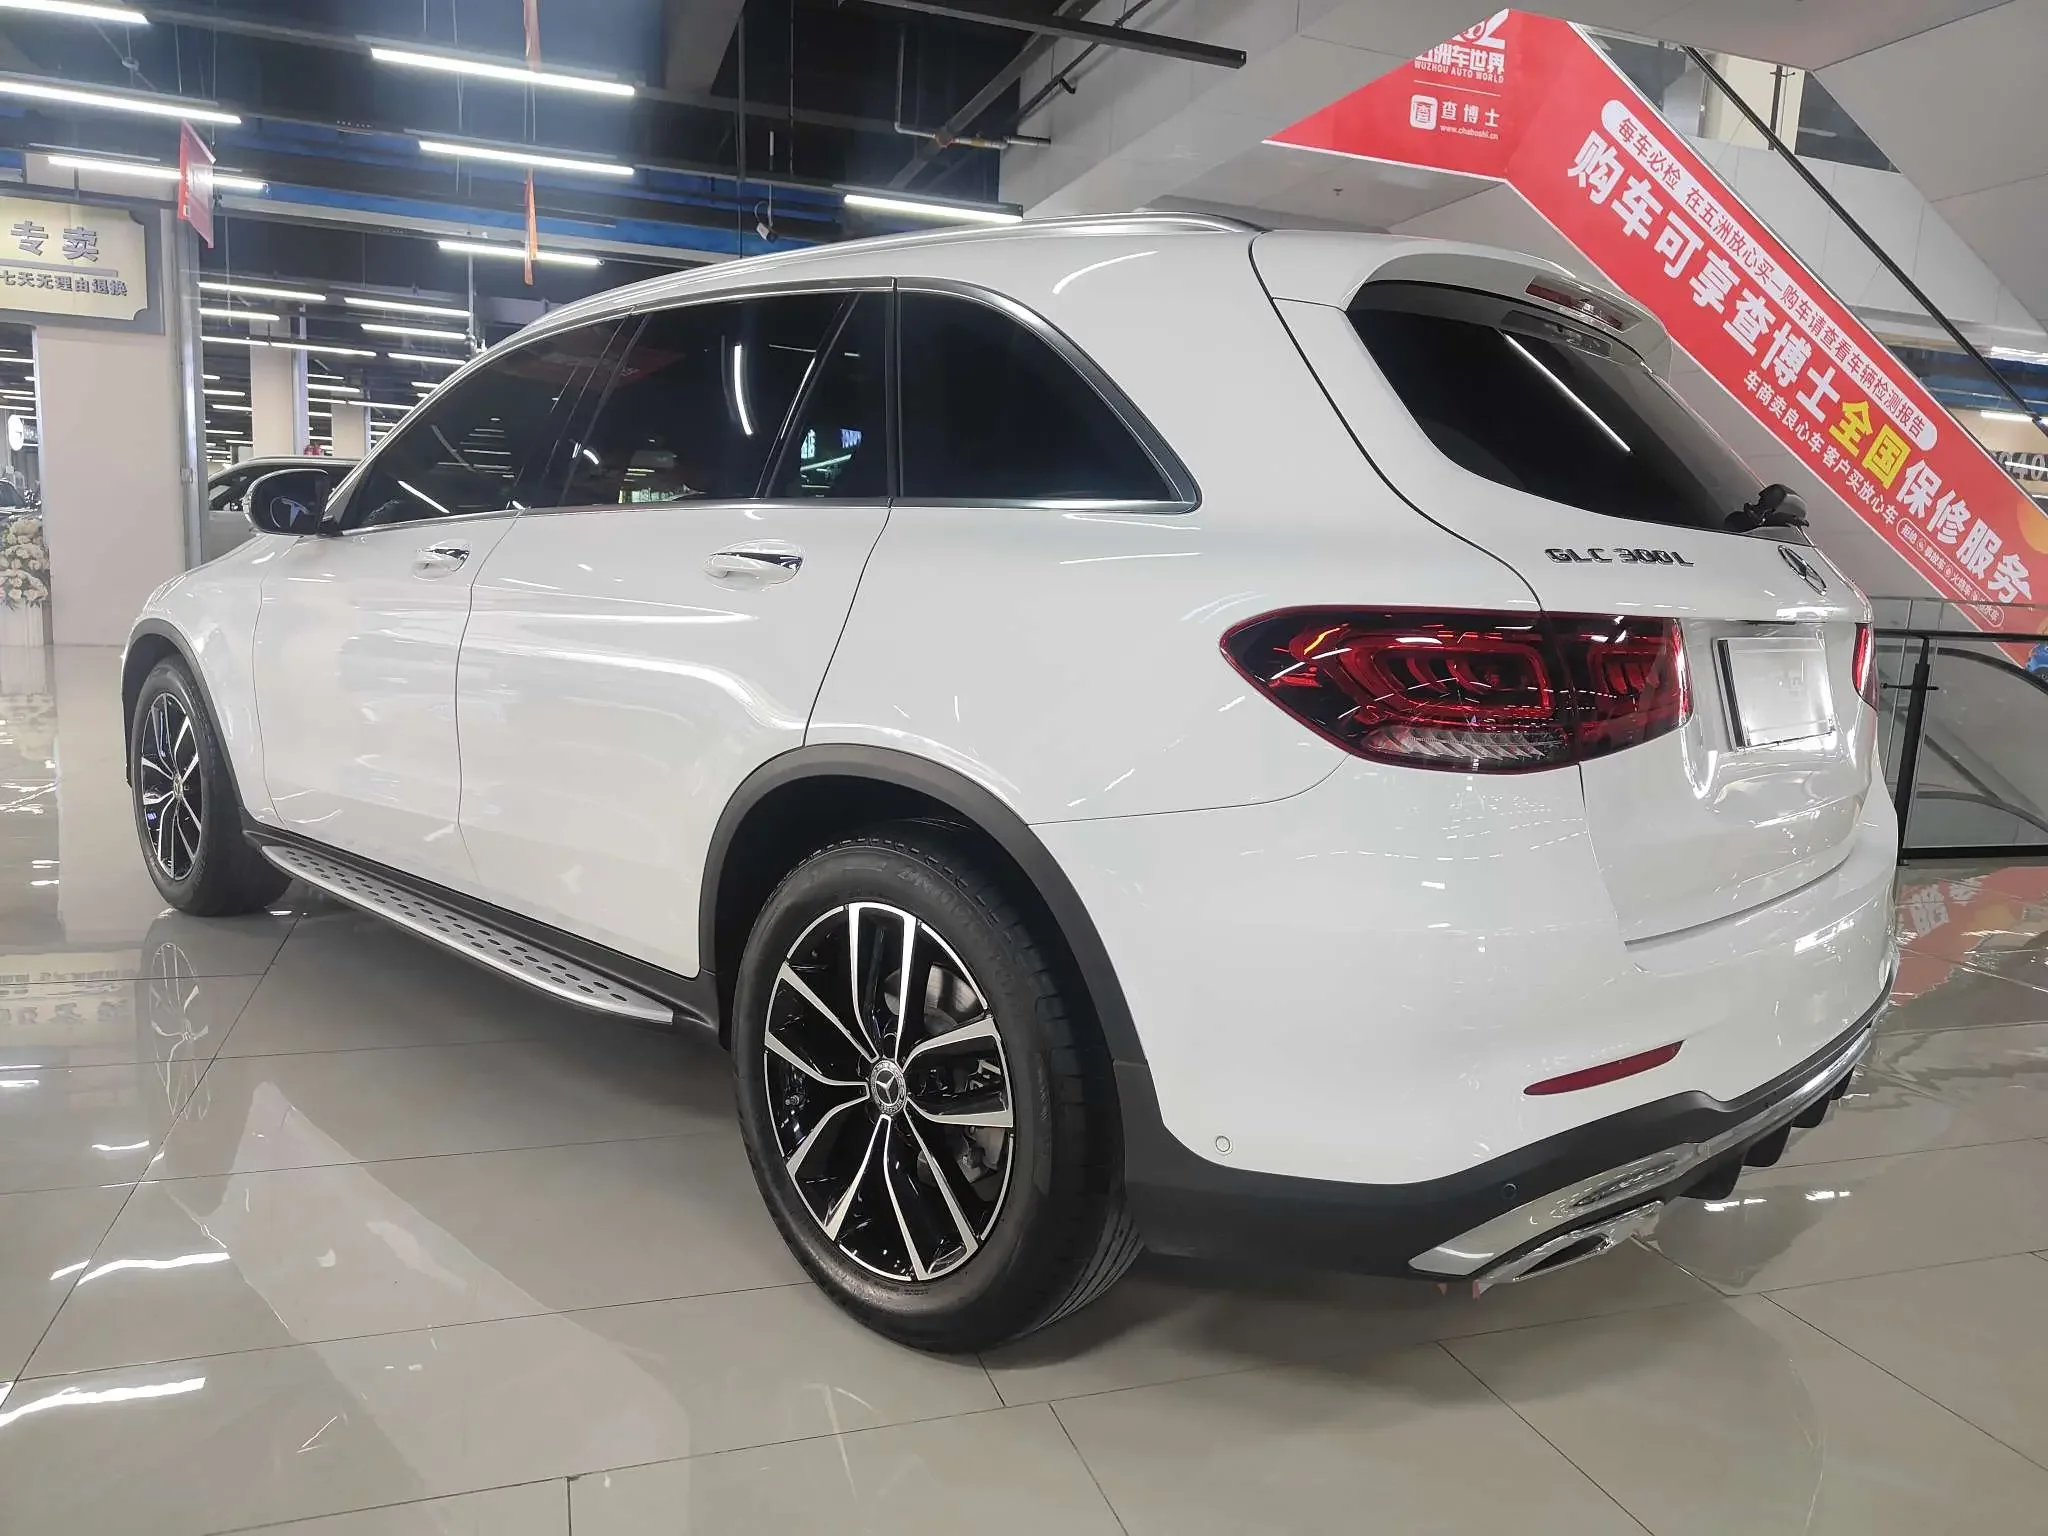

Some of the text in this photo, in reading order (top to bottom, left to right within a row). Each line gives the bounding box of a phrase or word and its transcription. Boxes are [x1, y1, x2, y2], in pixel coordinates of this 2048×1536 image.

[1414, 60, 1505, 84] WUZHOU AUTO WORLD
[1441, 100, 1500, 128] 查博士
[1618, 118, 1682, 191] 每车必检
[11, 220, 98, 262] 专卖
[0, 270, 127, 296] 七天无理由退换
[1567, 130, 2032, 603] 购车可享查博士全国保修服务
[1743, 369, 1899, 526] 车商卖良心车 客户买放心车
[1545, 548, 1695, 568] GLC 300L
